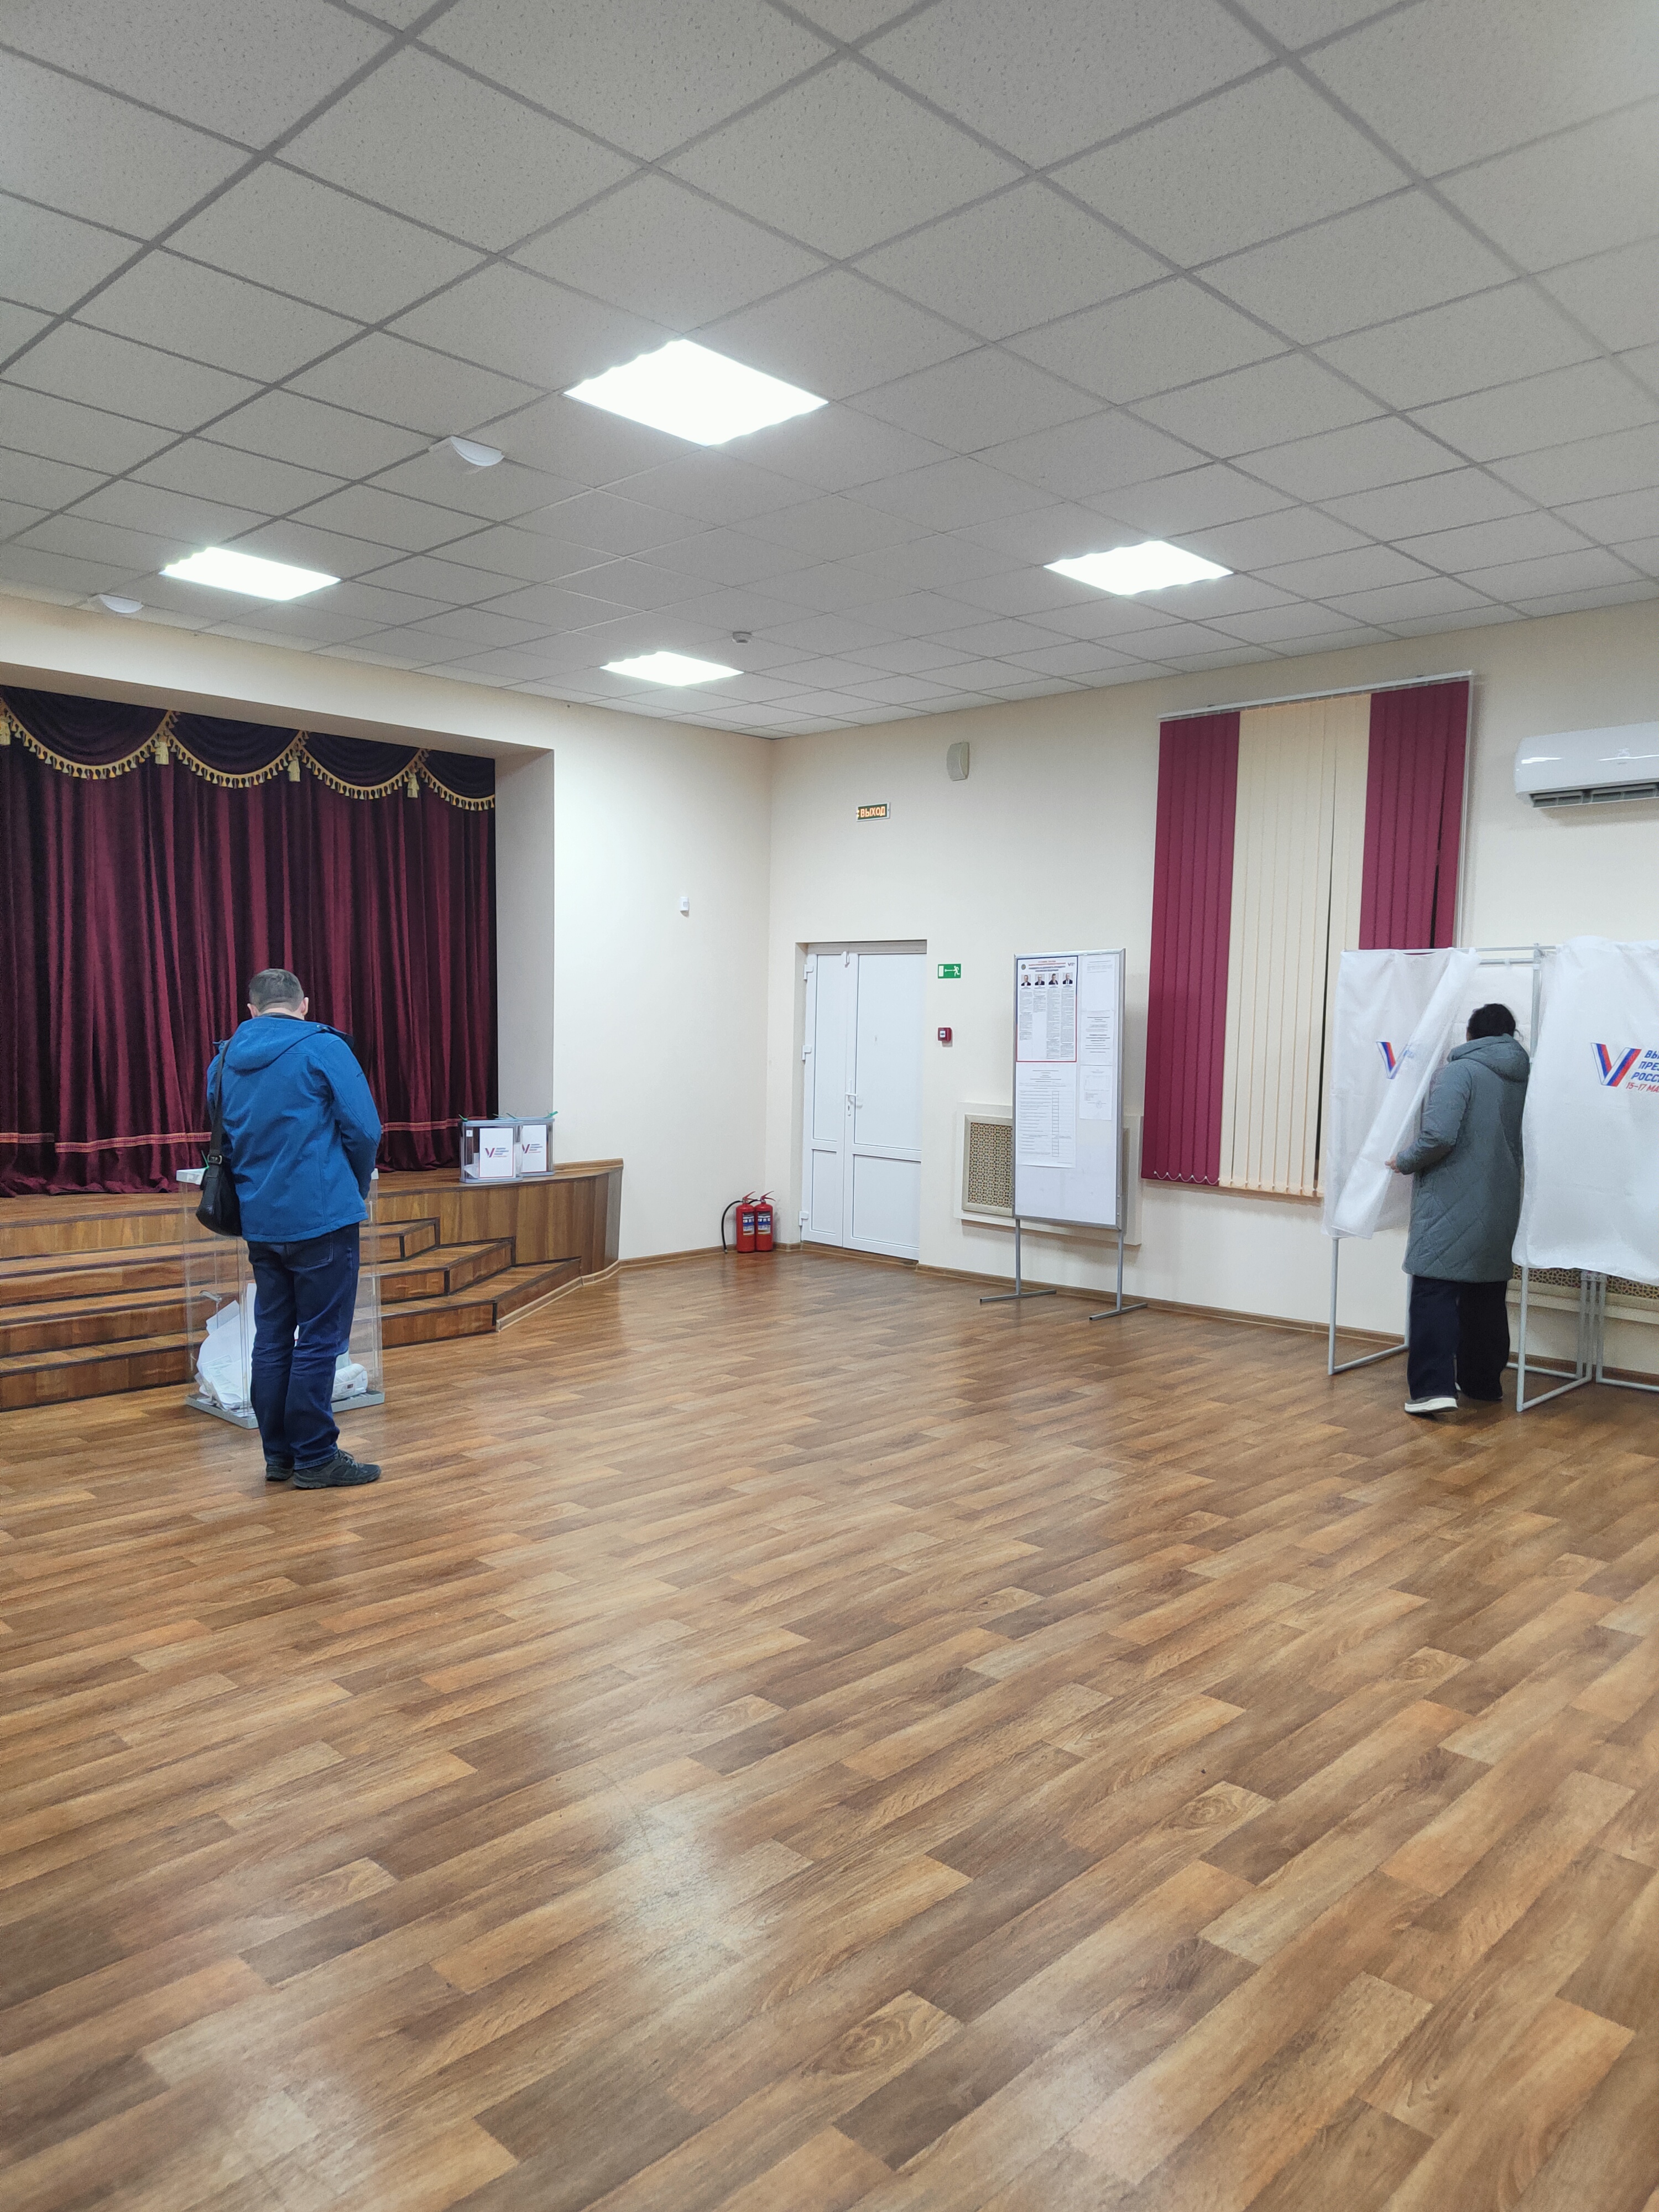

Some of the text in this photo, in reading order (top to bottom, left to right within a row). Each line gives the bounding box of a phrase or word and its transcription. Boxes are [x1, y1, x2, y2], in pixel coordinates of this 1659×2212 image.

[860, 806, 885, 817] ВЫХОД
[1590, 1042, 1642, 1087] V
[1631, 1072, 1659, 1083] РОСС
